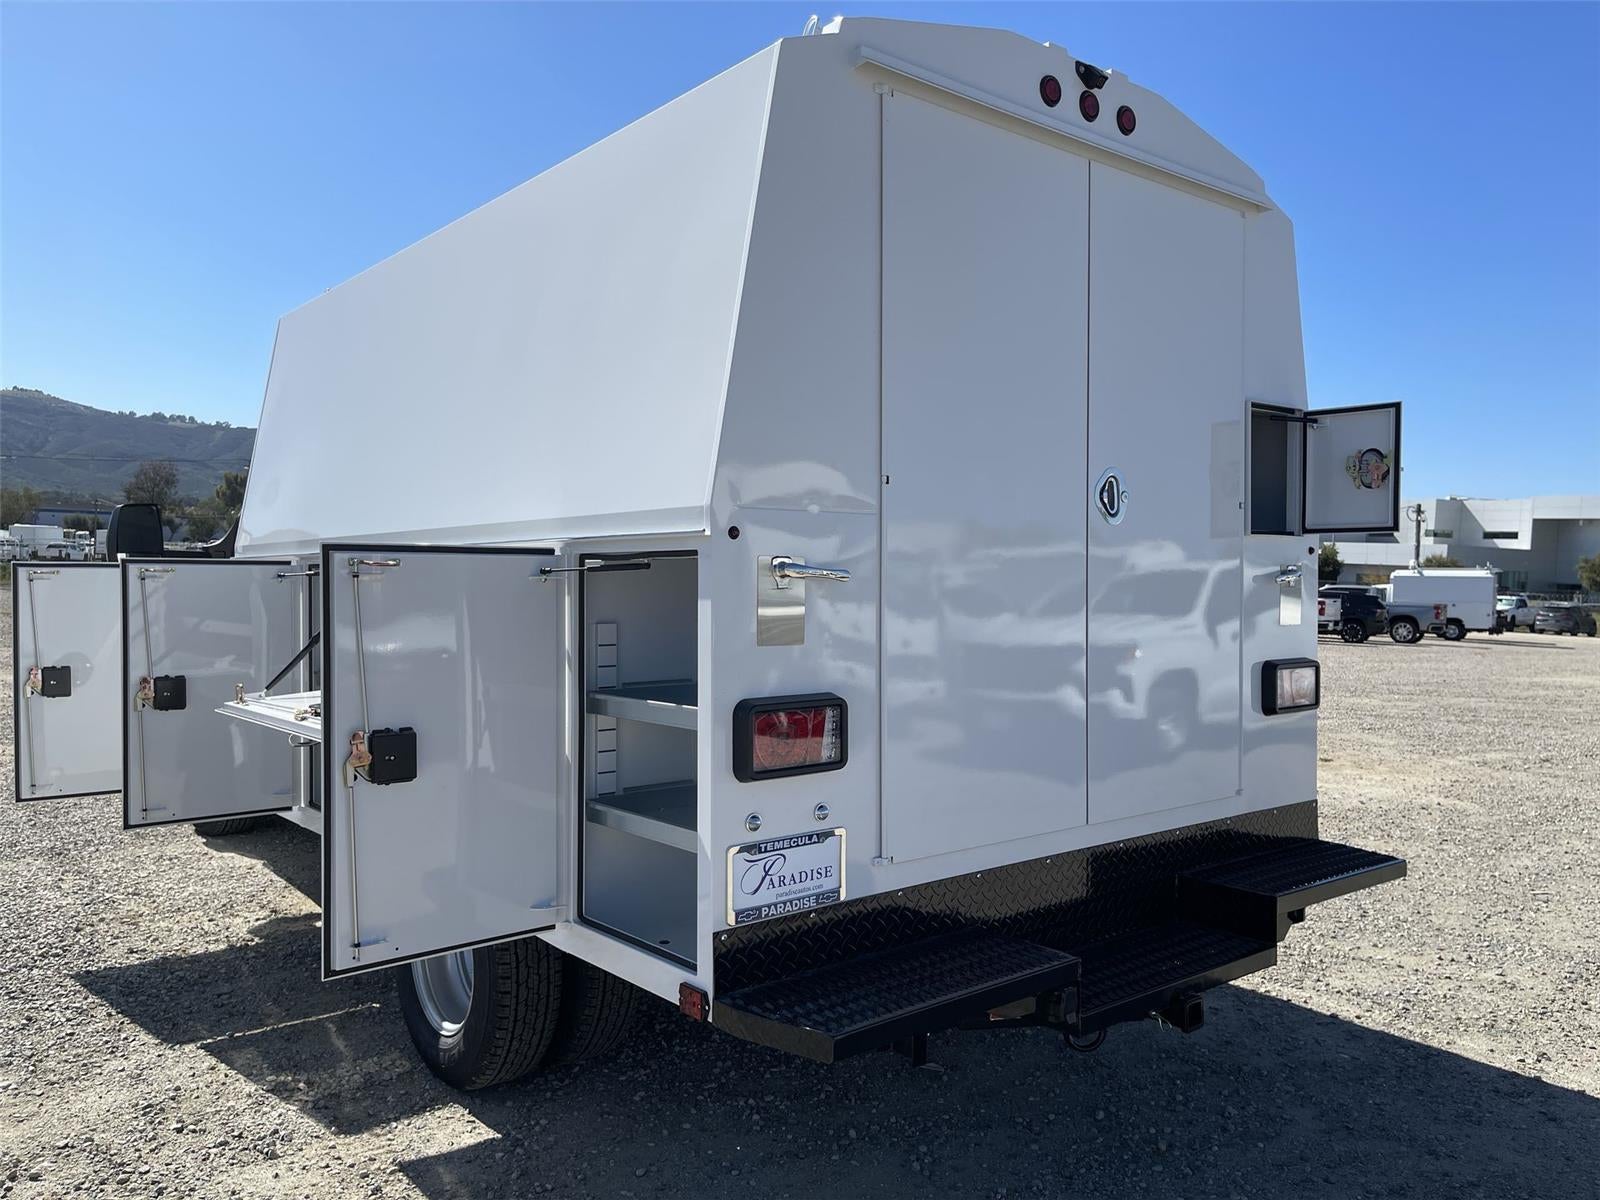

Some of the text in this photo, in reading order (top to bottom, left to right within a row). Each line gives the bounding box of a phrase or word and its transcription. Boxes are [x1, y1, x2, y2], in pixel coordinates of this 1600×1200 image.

[760, 835, 818, 852] TEMECULA
[741, 853, 833, 895] PARADISE
[761, 896, 817, 918] PARADISE
